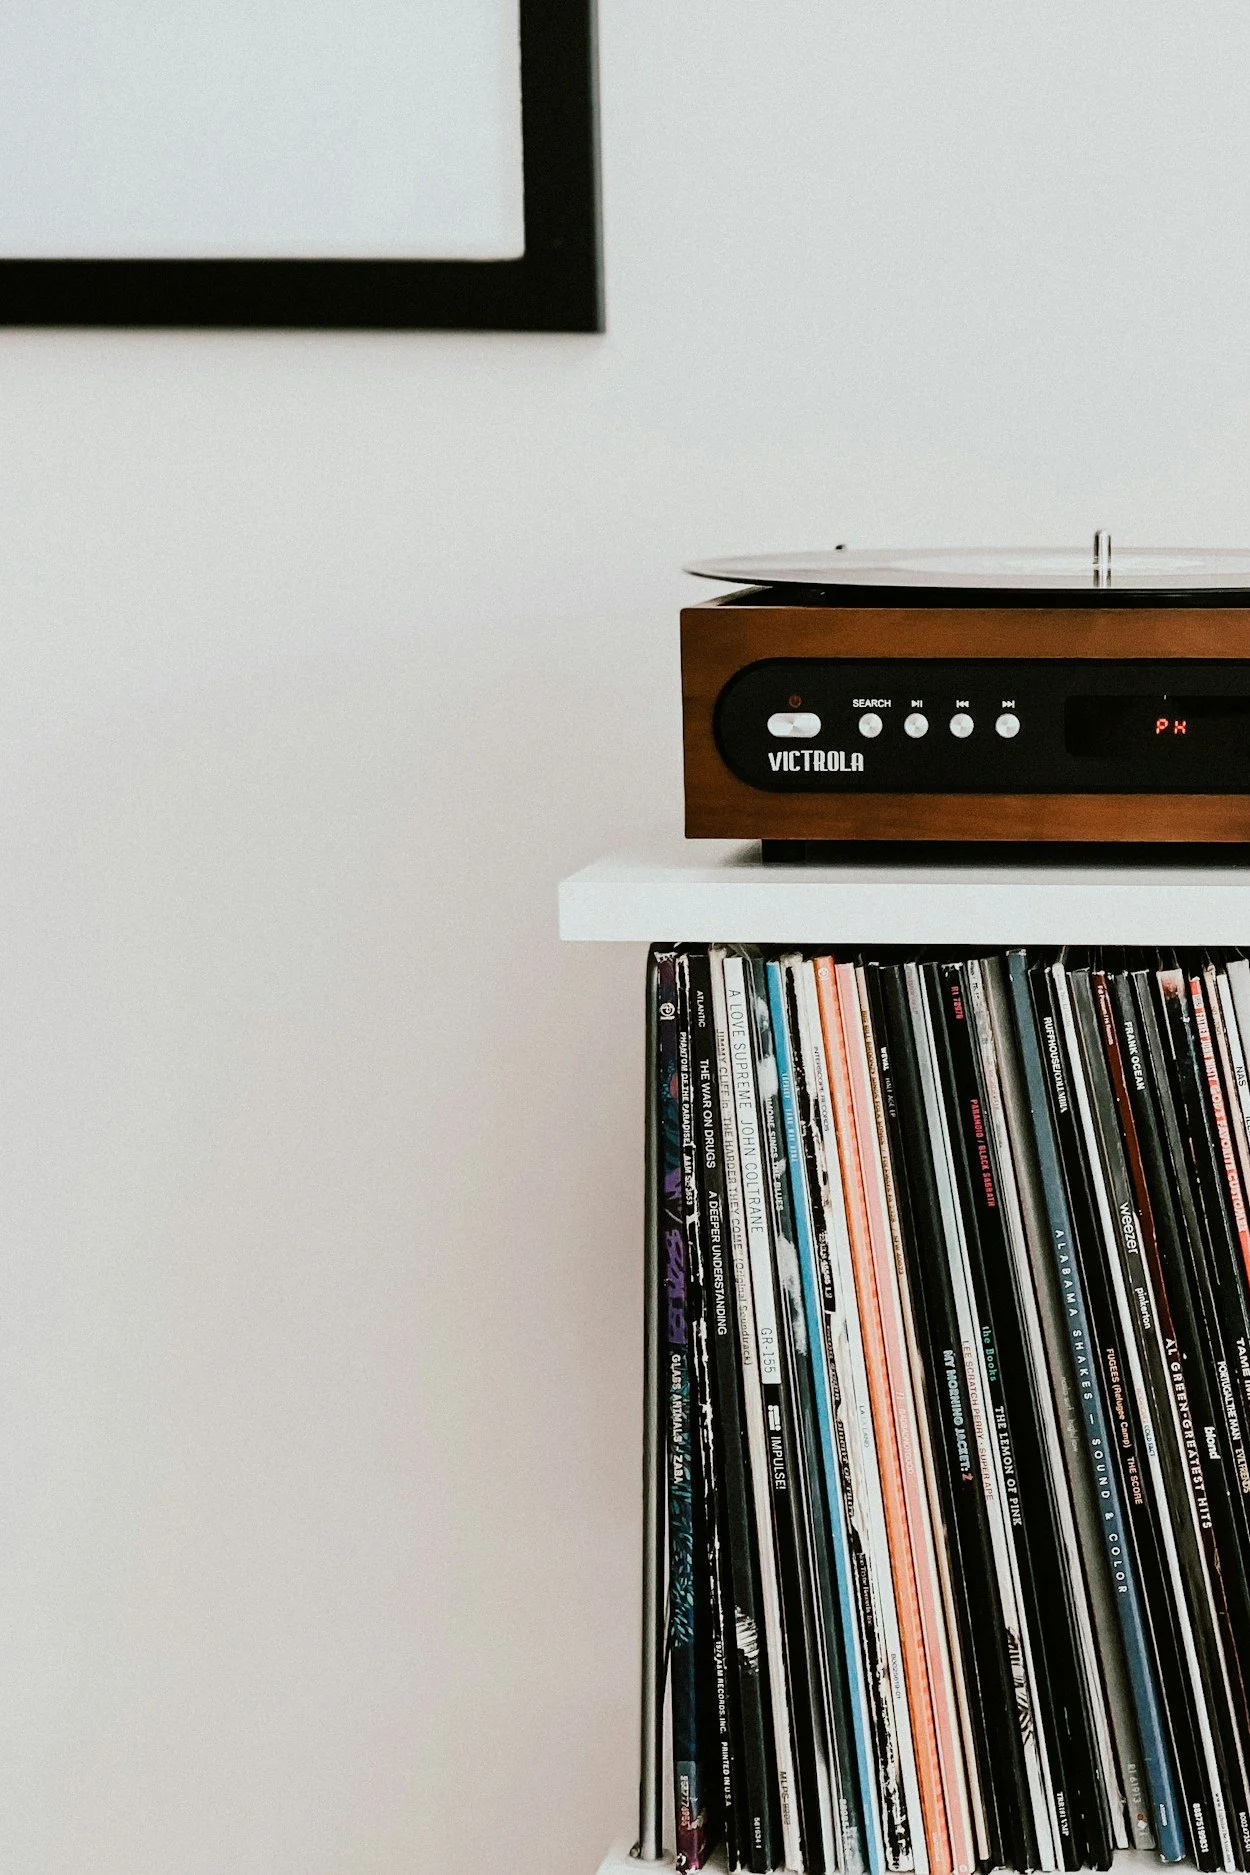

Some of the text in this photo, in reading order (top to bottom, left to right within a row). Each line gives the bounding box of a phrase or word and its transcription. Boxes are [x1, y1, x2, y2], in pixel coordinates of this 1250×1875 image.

[852, 699, 892, 708] SEARCH
[768, 751, 864, 771] VICTROLA
[696, 990, 706, 1027] ATLANTIC
[680, 1032, 688, 1070] PHANTOM
[880, 1047, 890, 1071] WEVAL
[1042, 1016, 1069, 1113] RUFFHOUSE/COLUMBIA
[1123, 1021, 1146, 1091] FRANK OCEAN
[719, 1067, 729, 1096] CLIFF
[814, 1047, 830, 1132] INTERSCOPE RECORDS
[1235, 1066, 1247, 1087] NAS
[683, 1103, 691, 1143] PARADISE
[722, 1099, 730, 1109] in
[729, 989, 765, 1233] A LOVE SUPREME JOHN COLTRANE
[1196, 1012, 1210, 1037] FATHER
[1217, 1121, 1237, 1170] FAVORITE
[1227, 1173, 1249, 1231] CUSTOMER
[726, 1140, 737, 1183] HARDER
[970, 1099, 996, 1207] PARANOID BLACK SABBATH
[699, 1059, 727, 1335] THE WAR ON DRUGS A DEEPER UNDERSTANDING
[729, 1187, 740, 1214] THEY
[1118, 1201, 1140, 1254] weezer
[1135, 1286, 1154, 1330] pinkerton
[761, 1327, 777, 1374] GR-155
[981, 1326, 999, 1382] the Books
[671, 1354, 685, 1483] GLASS ANIMALS ZABA
[859, 1406, 866, 1415] LA
[943, 1349, 972, 1472] MY MORNING JACKET:
[962, 1340, 994, 1501] LEE SCRATCH PERRY SUPER APE
[1055, 1229, 1128, 1594] ALABAMA SHAKES SOUND & COLOR
[1105, 1348, 1145, 1505] FUGEES (Refugee Camp) THE SCORE
[1228, 1419, 1242, 1441] MAN
[1144, 1425, 1153, 1441] COLD
[1165, 1337, 1213, 1529] AL HITS
[1203, 1426, 1222, 1459] blond
[770, 1436, 787, 1489] IMPULSE!
[994, 1406, 1024, 1527] THE LEMON OF PINK
[1234, 1448, 1247, 1464] EVIL
[722, 1742, 730, 1774] PRINTED
[724, 1777, 731, 1785] IN
